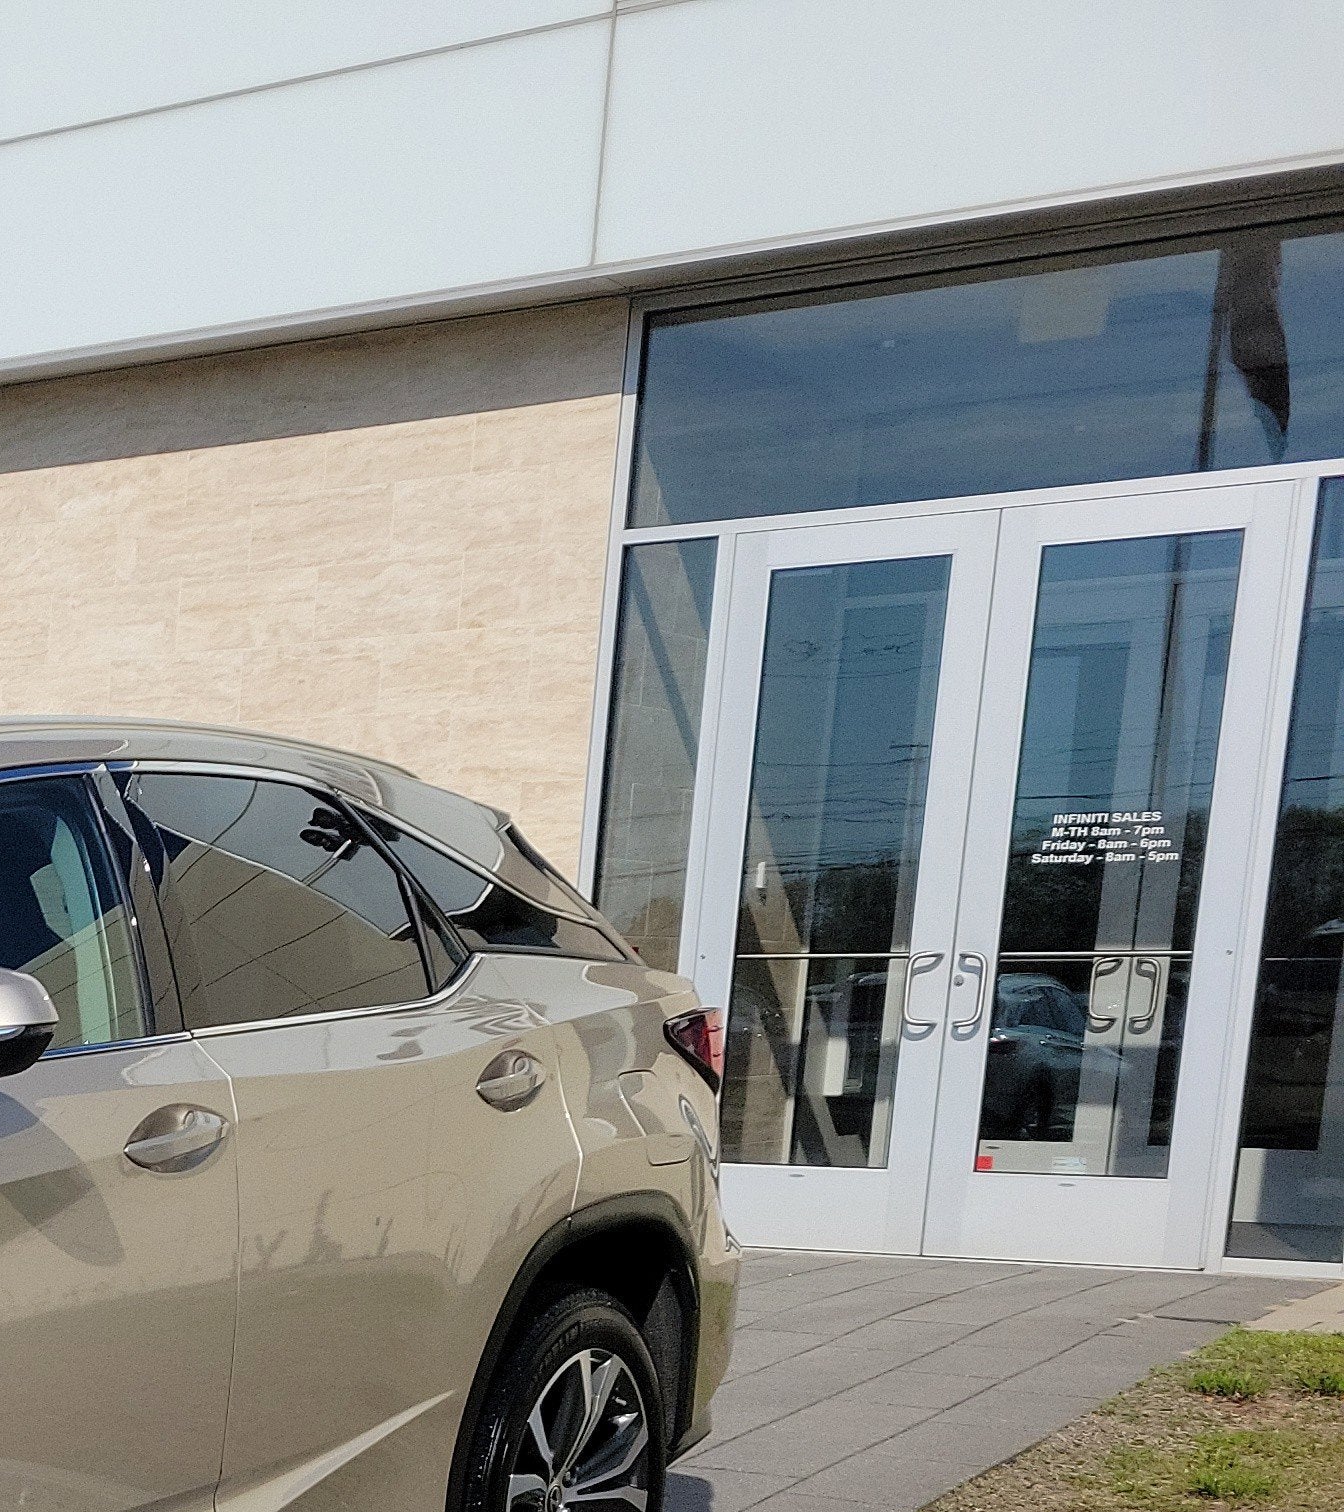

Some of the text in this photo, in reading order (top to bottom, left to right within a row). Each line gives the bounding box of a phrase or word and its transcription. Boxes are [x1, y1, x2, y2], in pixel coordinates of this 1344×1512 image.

[1053, 811, 1162, 824] INFINITI SALES
[1051, 826, 1088, 837] M-TH
[1091, 826, 1121, 837] 8am
[1134, 825, 1165, 836] 7pm
[1042, 840, 1086, 851] Friday
[1097, 839, 1128, 849] 8am
[1140, 838, 1172, 849] 6pm
[1031, 853, 1094, 865] Saturday
[1105, 852, 1136, 862] 8am
[1147, 851, 1179, 862] 5pm
